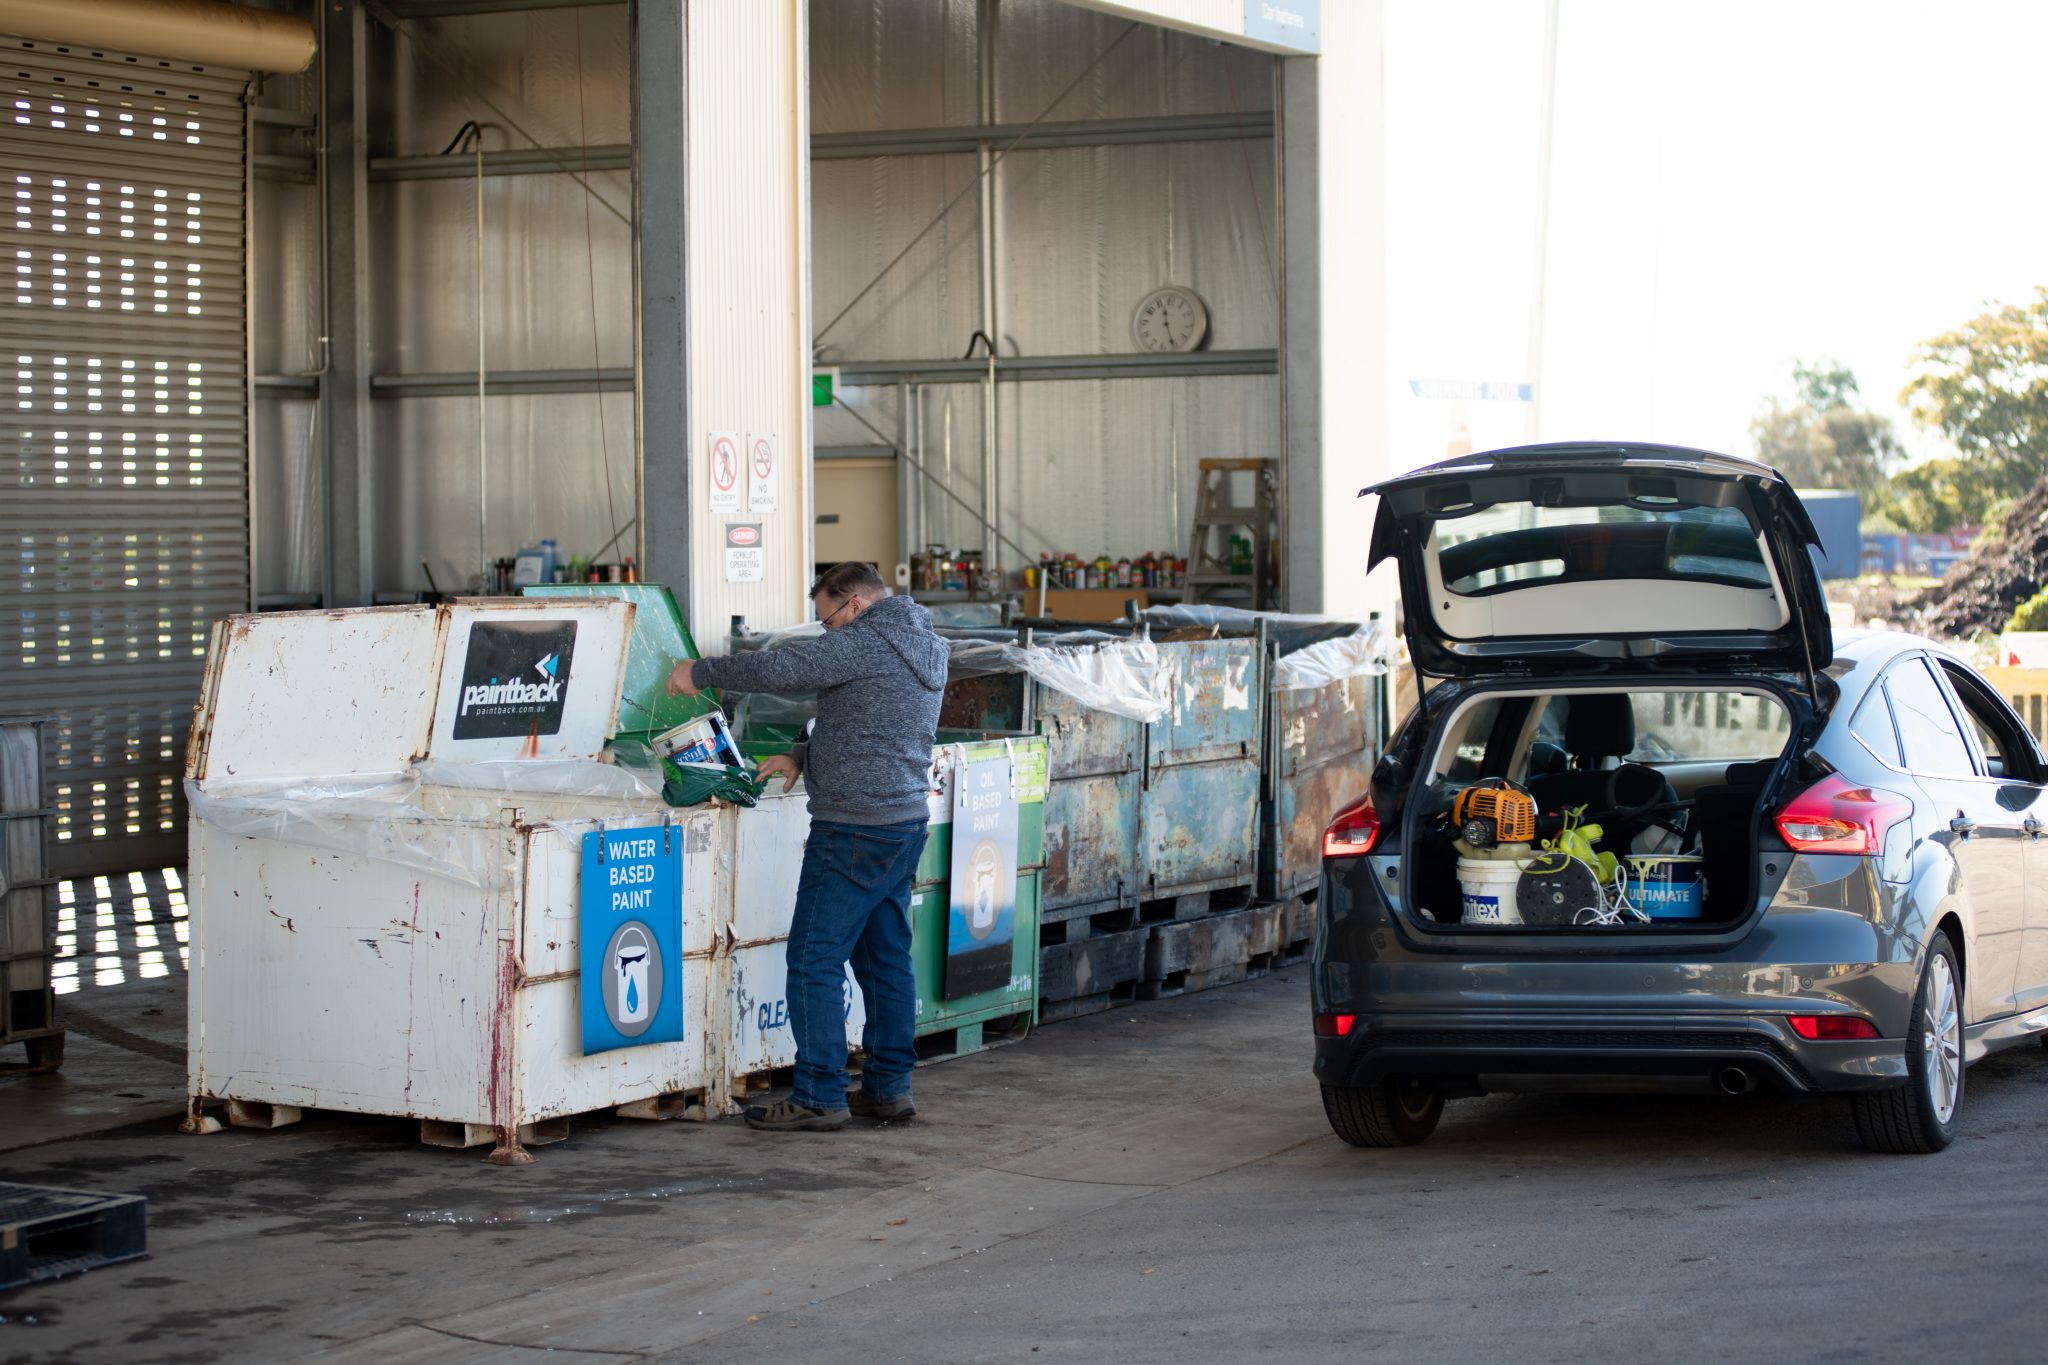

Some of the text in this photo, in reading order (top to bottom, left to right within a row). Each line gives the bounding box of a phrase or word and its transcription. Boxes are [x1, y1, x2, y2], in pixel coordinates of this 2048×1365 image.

[758, 484, 768, 494] NO
[752, 496, 774, 505] SMOKING
[733, 531, 755, 541] DANGER
[732, 550, 756, 559] FORKLIFT
[730, 560, 759, 569] OPERATING
[738, 569, 752, 578] AREA
[461, 675, 561, 716] paintback
[476, 705, 546, 716] paintback.com.au
[980, 770, 996, 788] OIL
[972, 792, 1001, 811] BASED
[974, 813, 1000, 832] PAINT
[609, 839, 655, 860] WATER
[610, 865, 654, 886] BASED
[612, 890, 652, 910] PAINT
[1629, 889, 1690, 902] ULTIMATE
